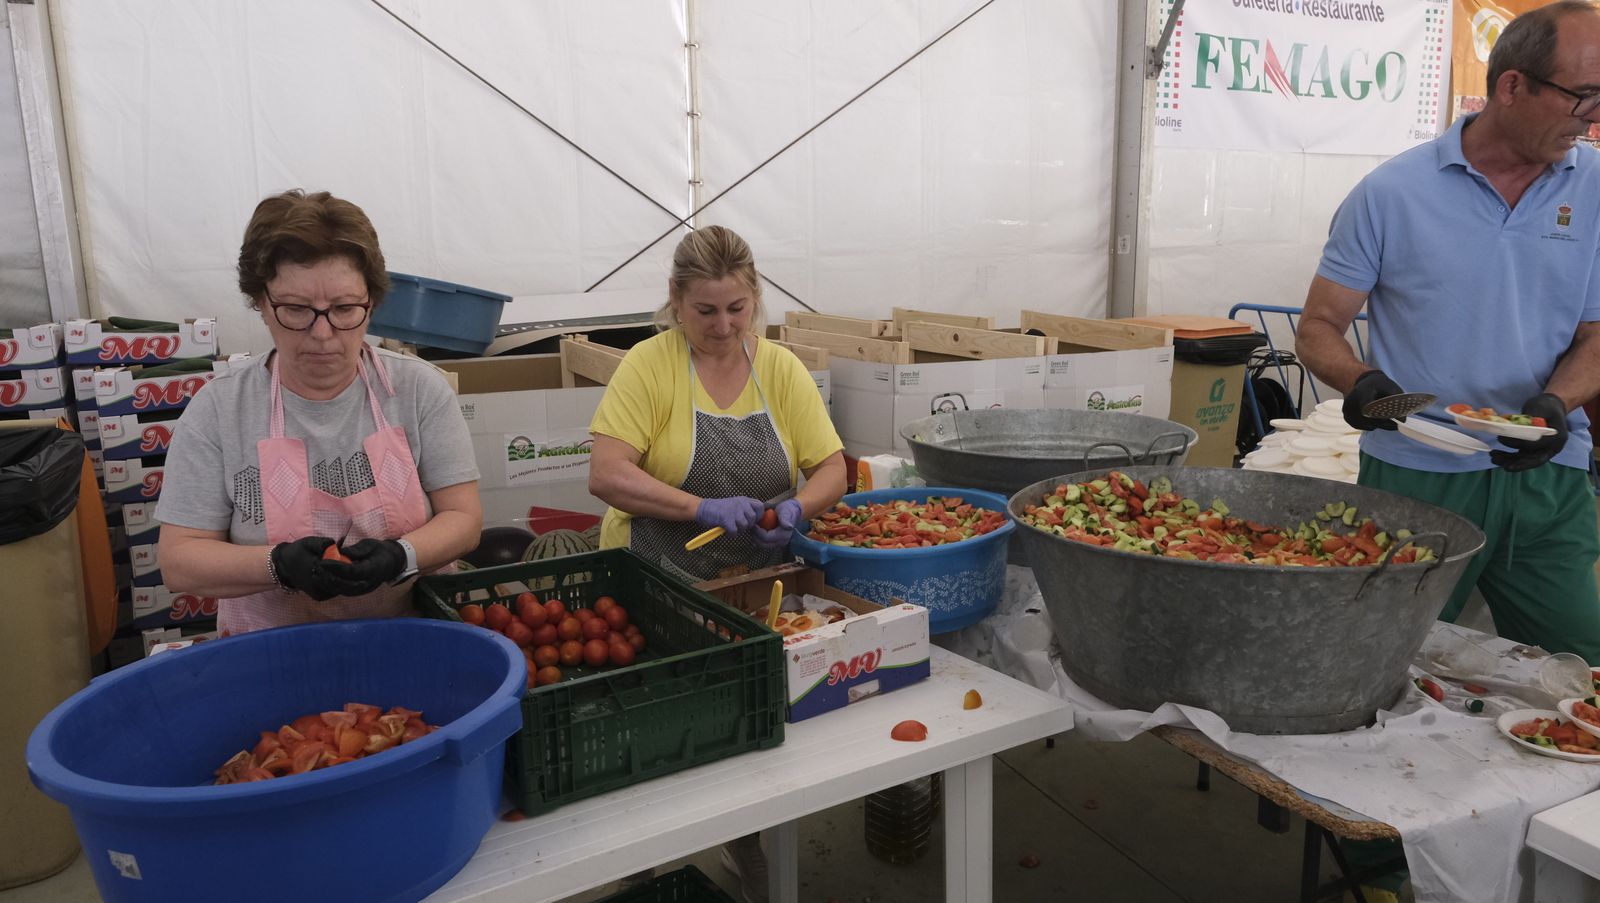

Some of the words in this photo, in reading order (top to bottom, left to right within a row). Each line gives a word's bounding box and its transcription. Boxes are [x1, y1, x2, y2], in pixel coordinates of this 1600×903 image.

[1302, 0, 1385, 22] Restaurante
[1191, 32, 1408, 102] FEMAGO
[1155, 116, 1182, 127] ioline
[0, 339, 19, 367] V
[98, 335, 181, 361] MV
[0, 380, 27, 407] V
[827, 646, 883, 686] MV
